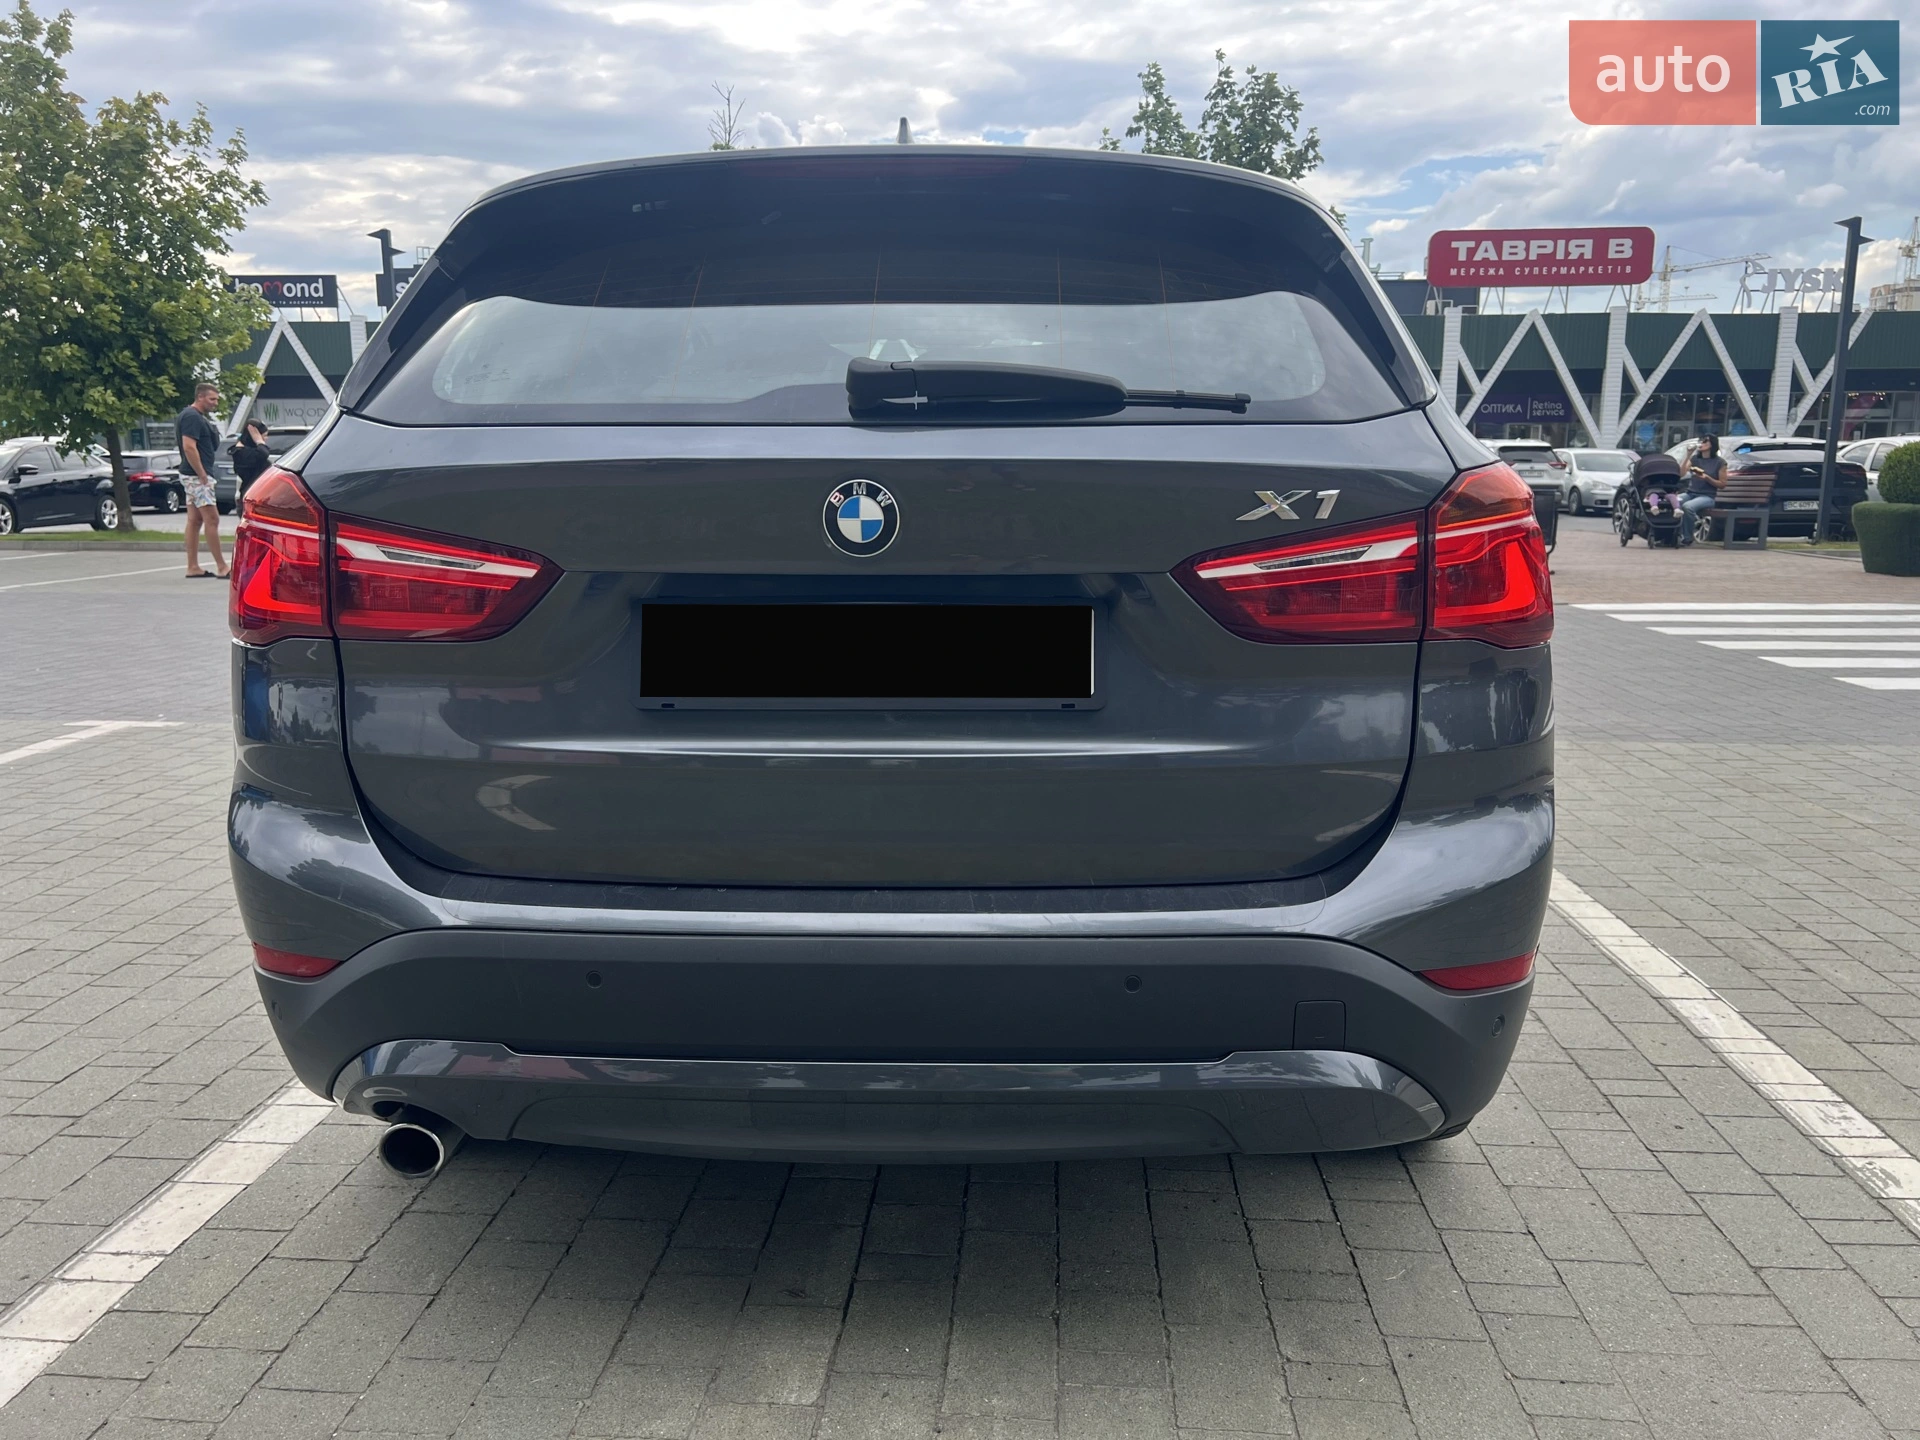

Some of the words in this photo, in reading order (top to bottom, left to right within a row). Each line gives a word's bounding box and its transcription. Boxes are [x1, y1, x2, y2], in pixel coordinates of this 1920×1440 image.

[1450, 239, 1593, 261] ТАВРІЯ
[1450, 267, 1505, 276] МЕРЕЖА
[1514, 265, 1632, 275] СУПЕРМАРКЕТІВ
[1760, 267, 1846, 294] JYSK
[1481, 403, 1522, 414] ОПТИКА
[1532, 400, 1562, 409] Retina
[829, 482, 893, 508] BMW
[1235, 489, 1341, 521] X1
